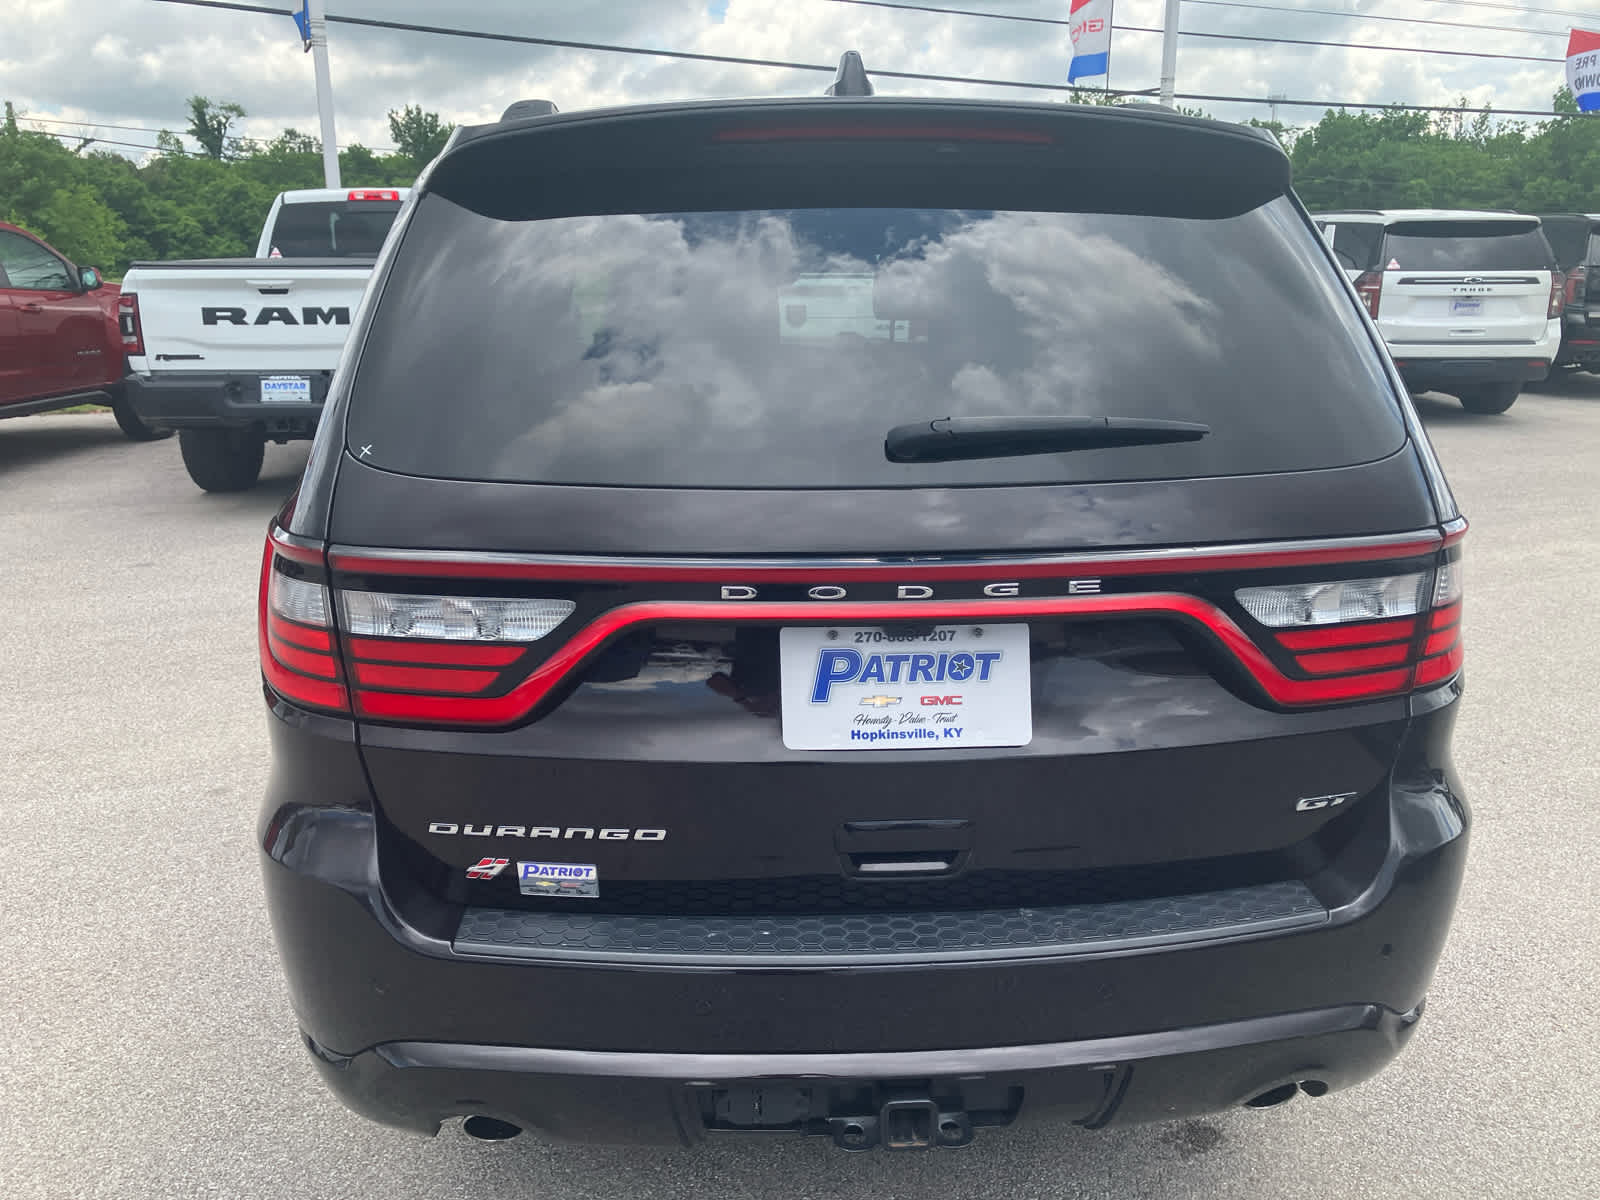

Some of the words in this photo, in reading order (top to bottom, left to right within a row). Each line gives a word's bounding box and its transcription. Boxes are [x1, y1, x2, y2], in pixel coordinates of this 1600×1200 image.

[201, 306, 350, 325] RAM
[264, 382, 306, 390] DAYSTAR
[720, 579, 1102, 600] DODGE
[811, 648, 1001, 704] PATRIOT
[920, 695, 963, 706] GMC
[853, 713, 892, 729] Honesty
[898, 712, 926, 725] Value
[932, 712, 958, 724] Trust
[851, 728, 939, 742] Hopkinsville,
[943, 727, 963, 738] KY
[1296, 791, 1358, 812] GT
[428, 822, 667, 841] DURANGO
[522, 864, 593, 880] PATRIOT
